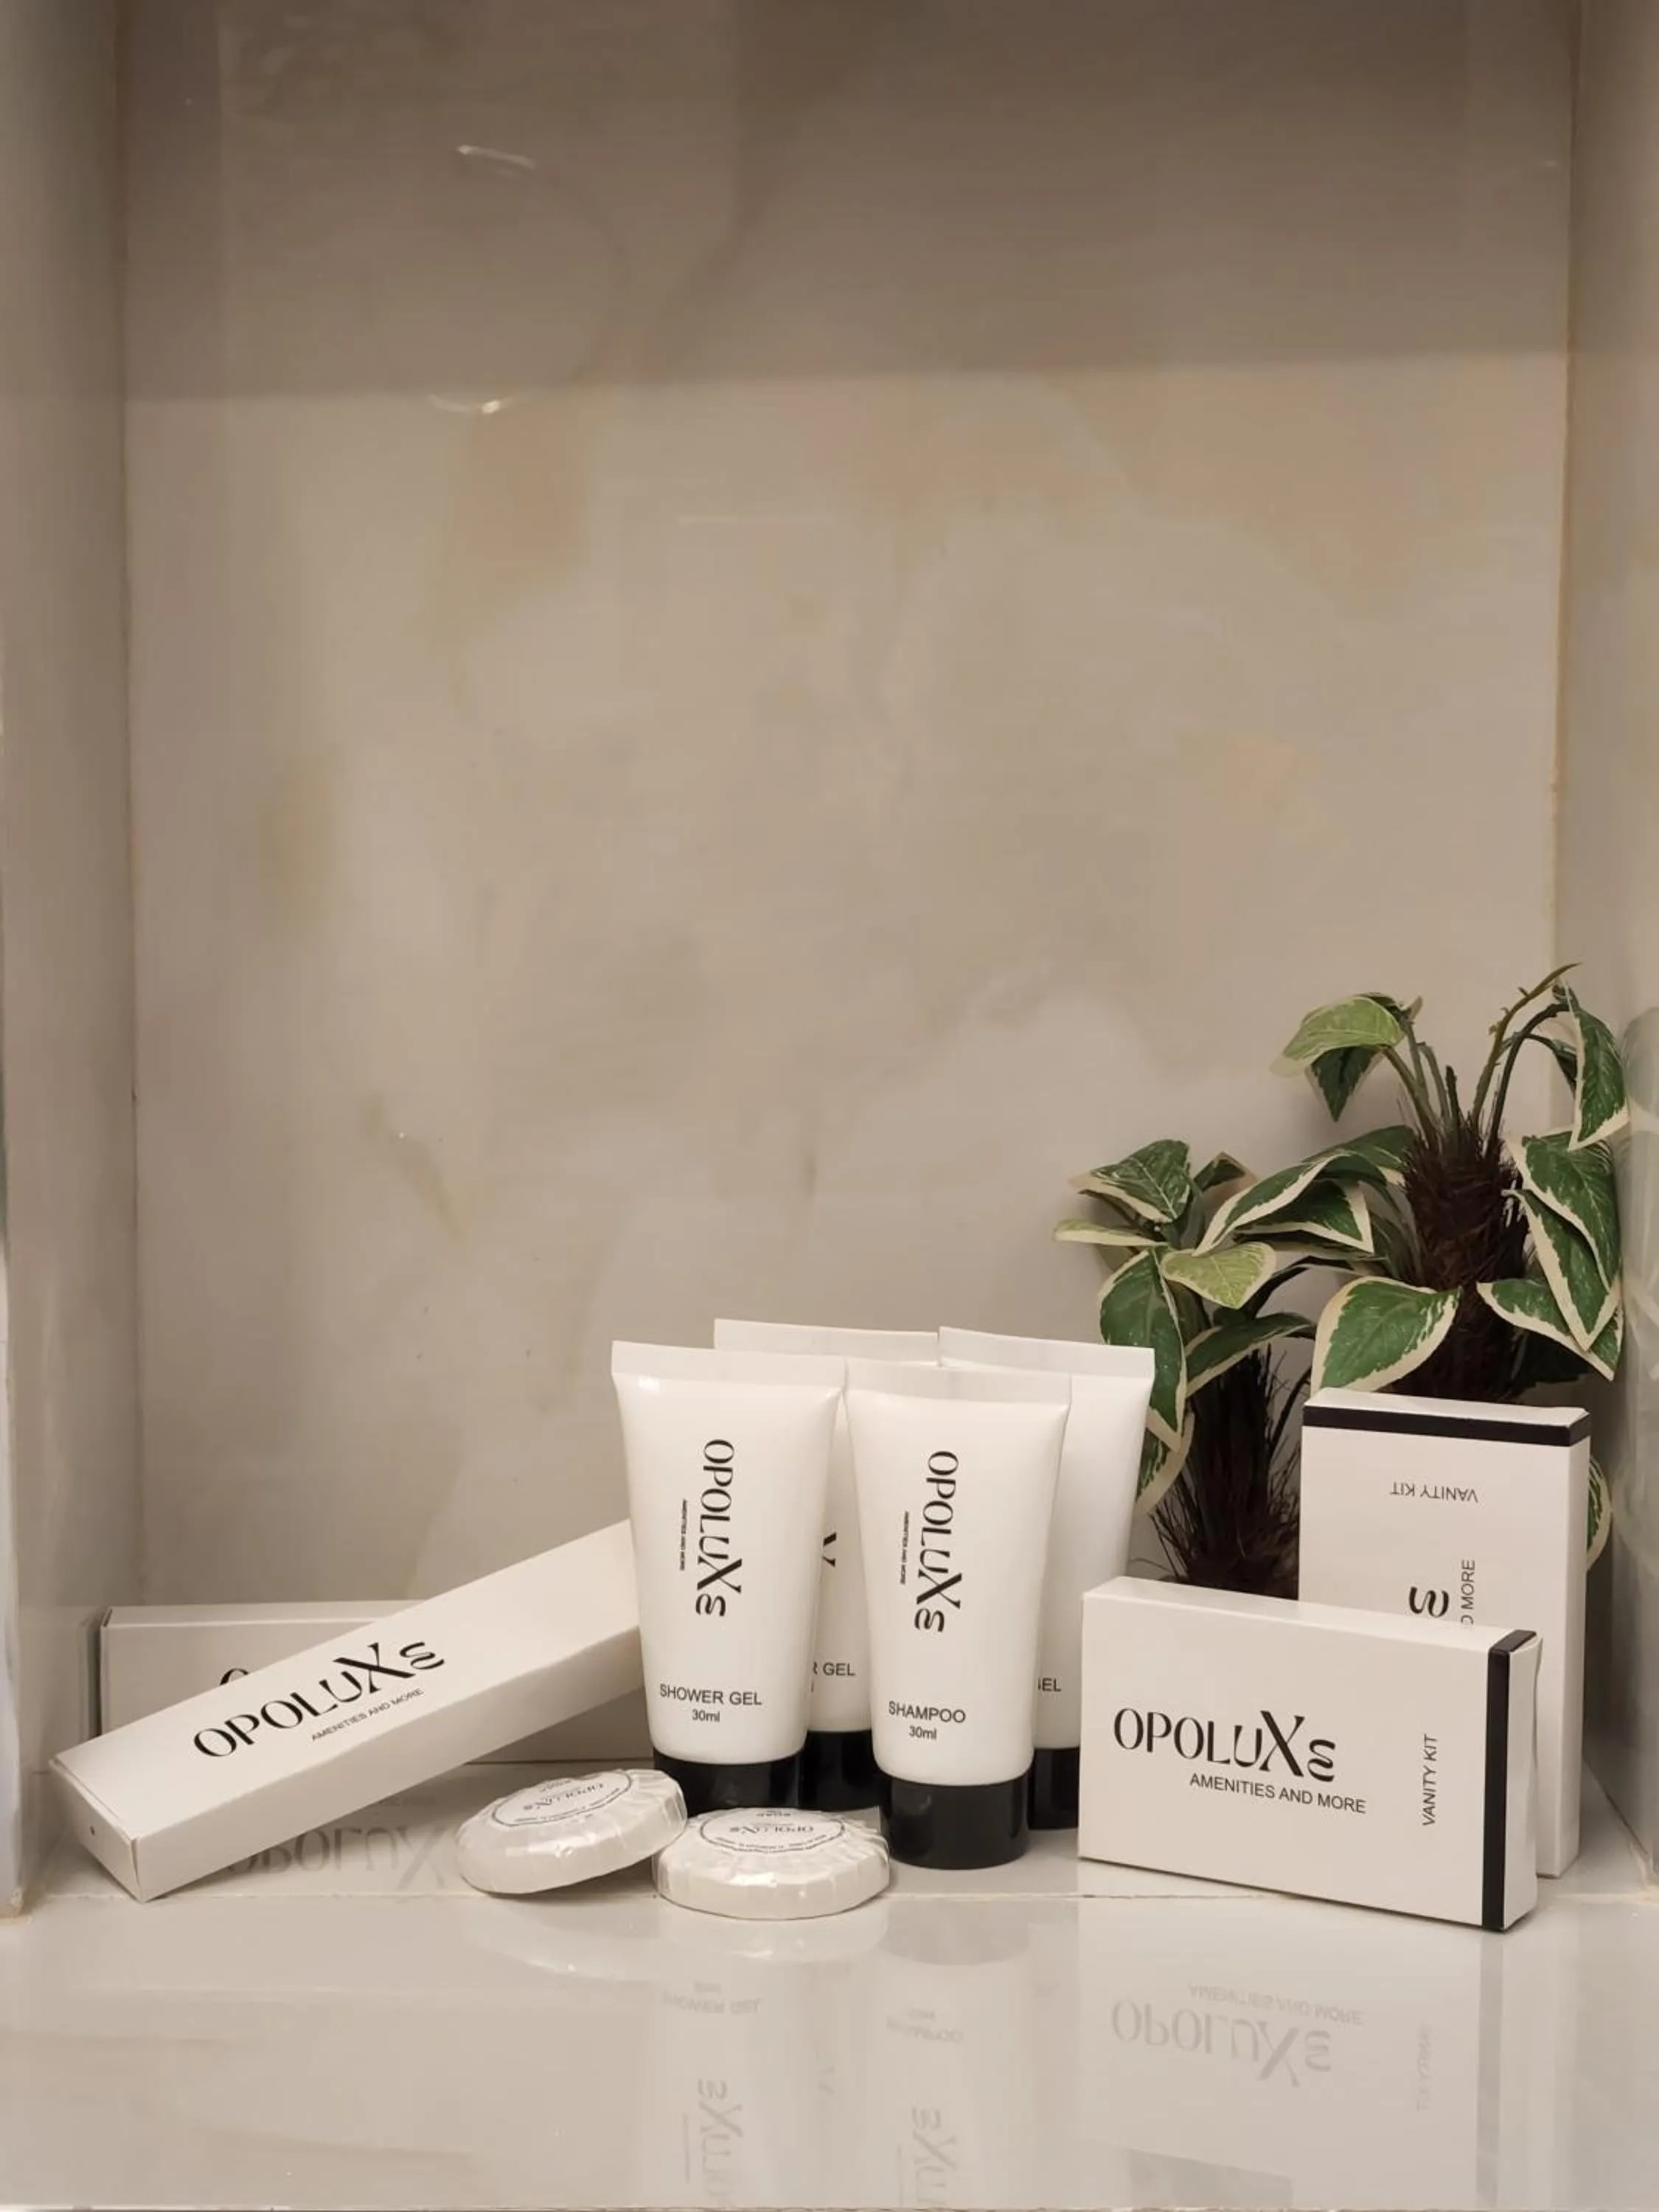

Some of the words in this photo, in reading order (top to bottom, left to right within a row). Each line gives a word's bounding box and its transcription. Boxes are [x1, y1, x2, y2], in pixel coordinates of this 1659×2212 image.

[1390, 1481, 1416, 1498] KIT
[1419, 1484, 1479, 1503] VANITY
[1460, 1559, 1475, 1610] MORE
[822, 1661, 856, 1677] GEL
[660, 1683, 724, 1705] SHOWER
[728, 1691, 762, 1706] GEL
[1037, 1677, 1062, 1692] EL
[692, 1708, 721, 1723] 30ml
[888, 1700, 967, 1724] SHAMPOO
[908, 1725, 937, 1740] 30ml
[1422, 1733, 1438, 1761] KIT
[1189, 1773, 1276, 1799] AMENITIES
[1279, 1787, 1313, 1805] AND
[1318, 1792, 1367, 1814] MORE
[1422, 1765, 1437, 1826] VANITY
